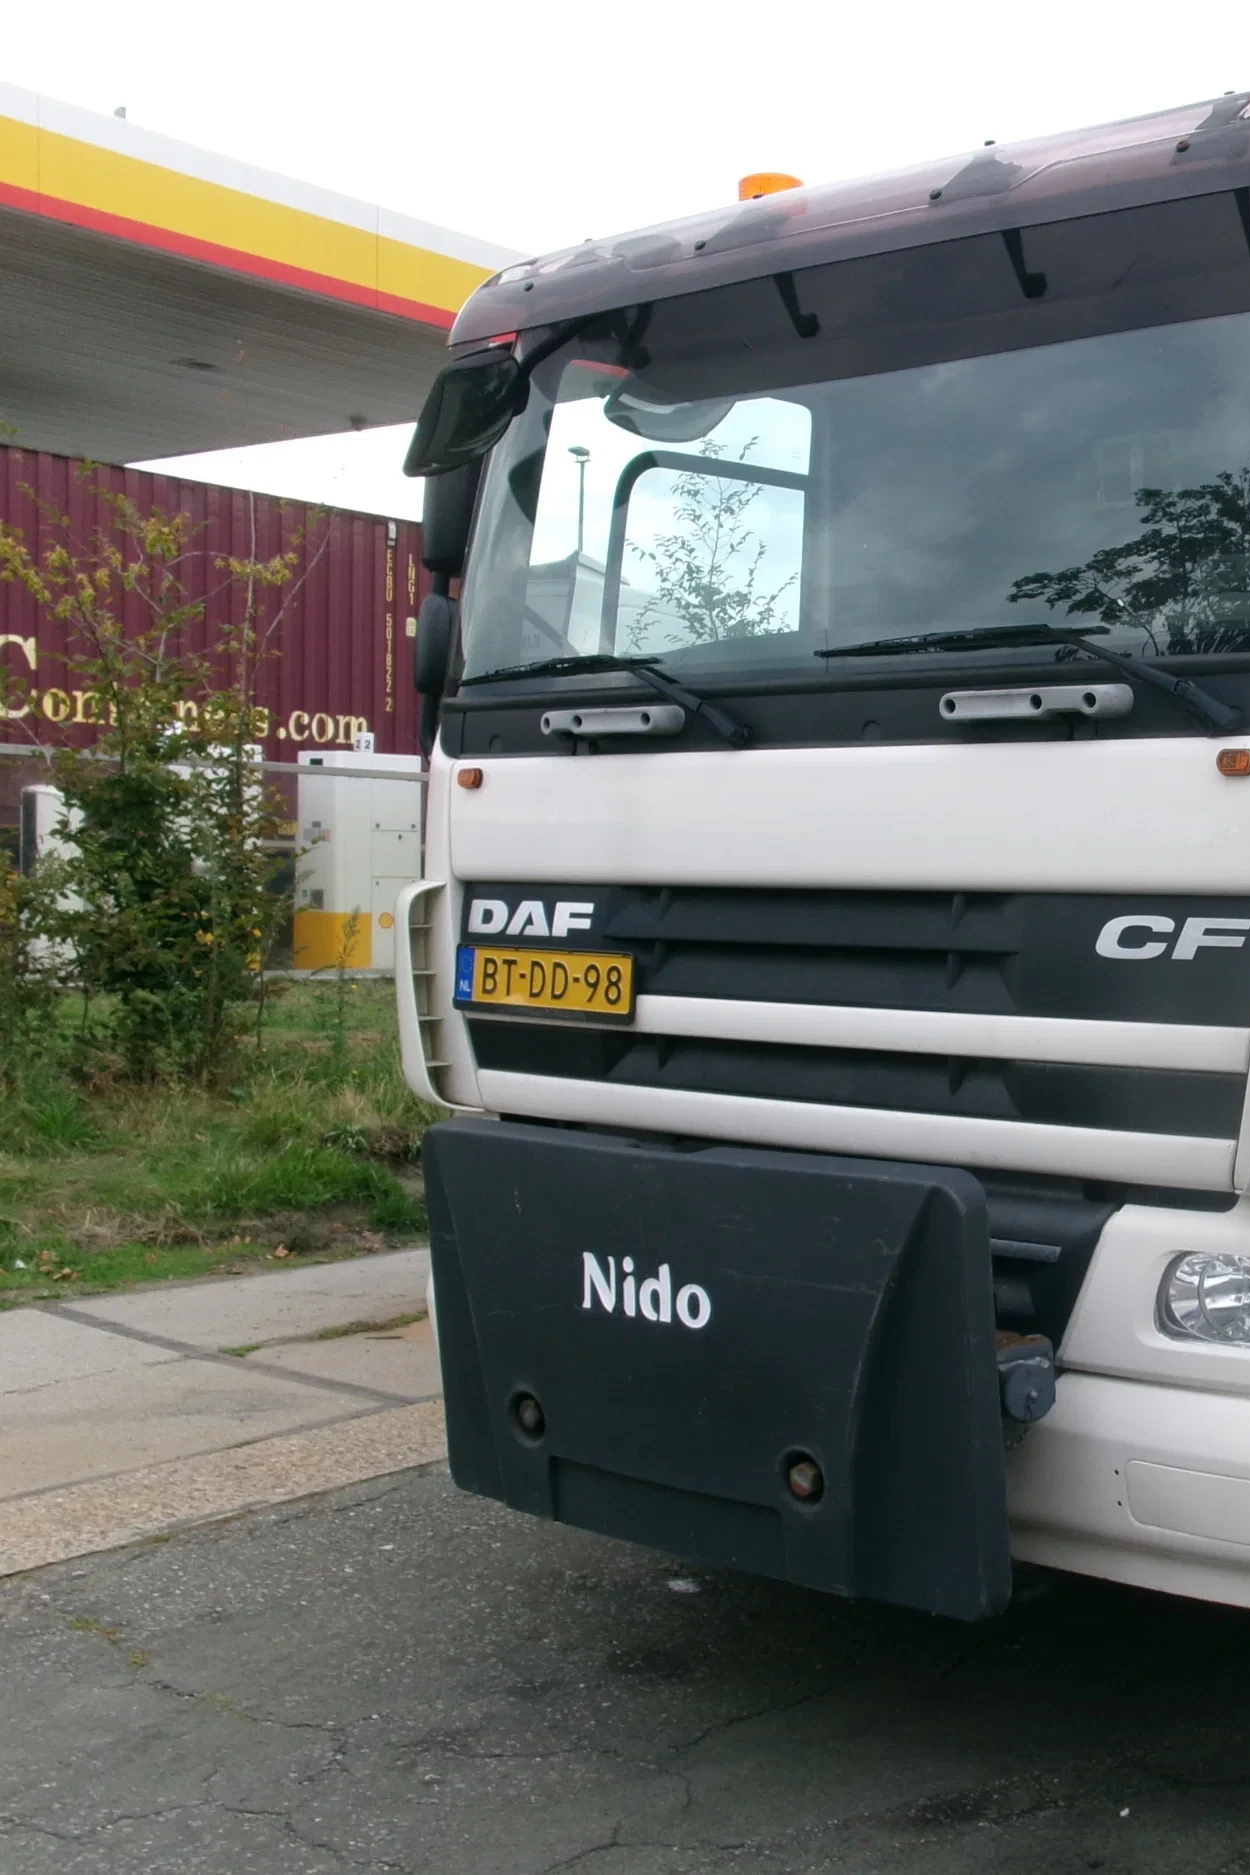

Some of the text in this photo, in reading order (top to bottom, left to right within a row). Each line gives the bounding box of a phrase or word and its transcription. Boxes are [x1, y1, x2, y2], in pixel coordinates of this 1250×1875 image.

[468, 899, 595, 937] DAF
[459, 979, 471, 992] NL
[481, 957, 622, 1005] BT-DD-98
[582, 1251, 711, 1329] Nido
